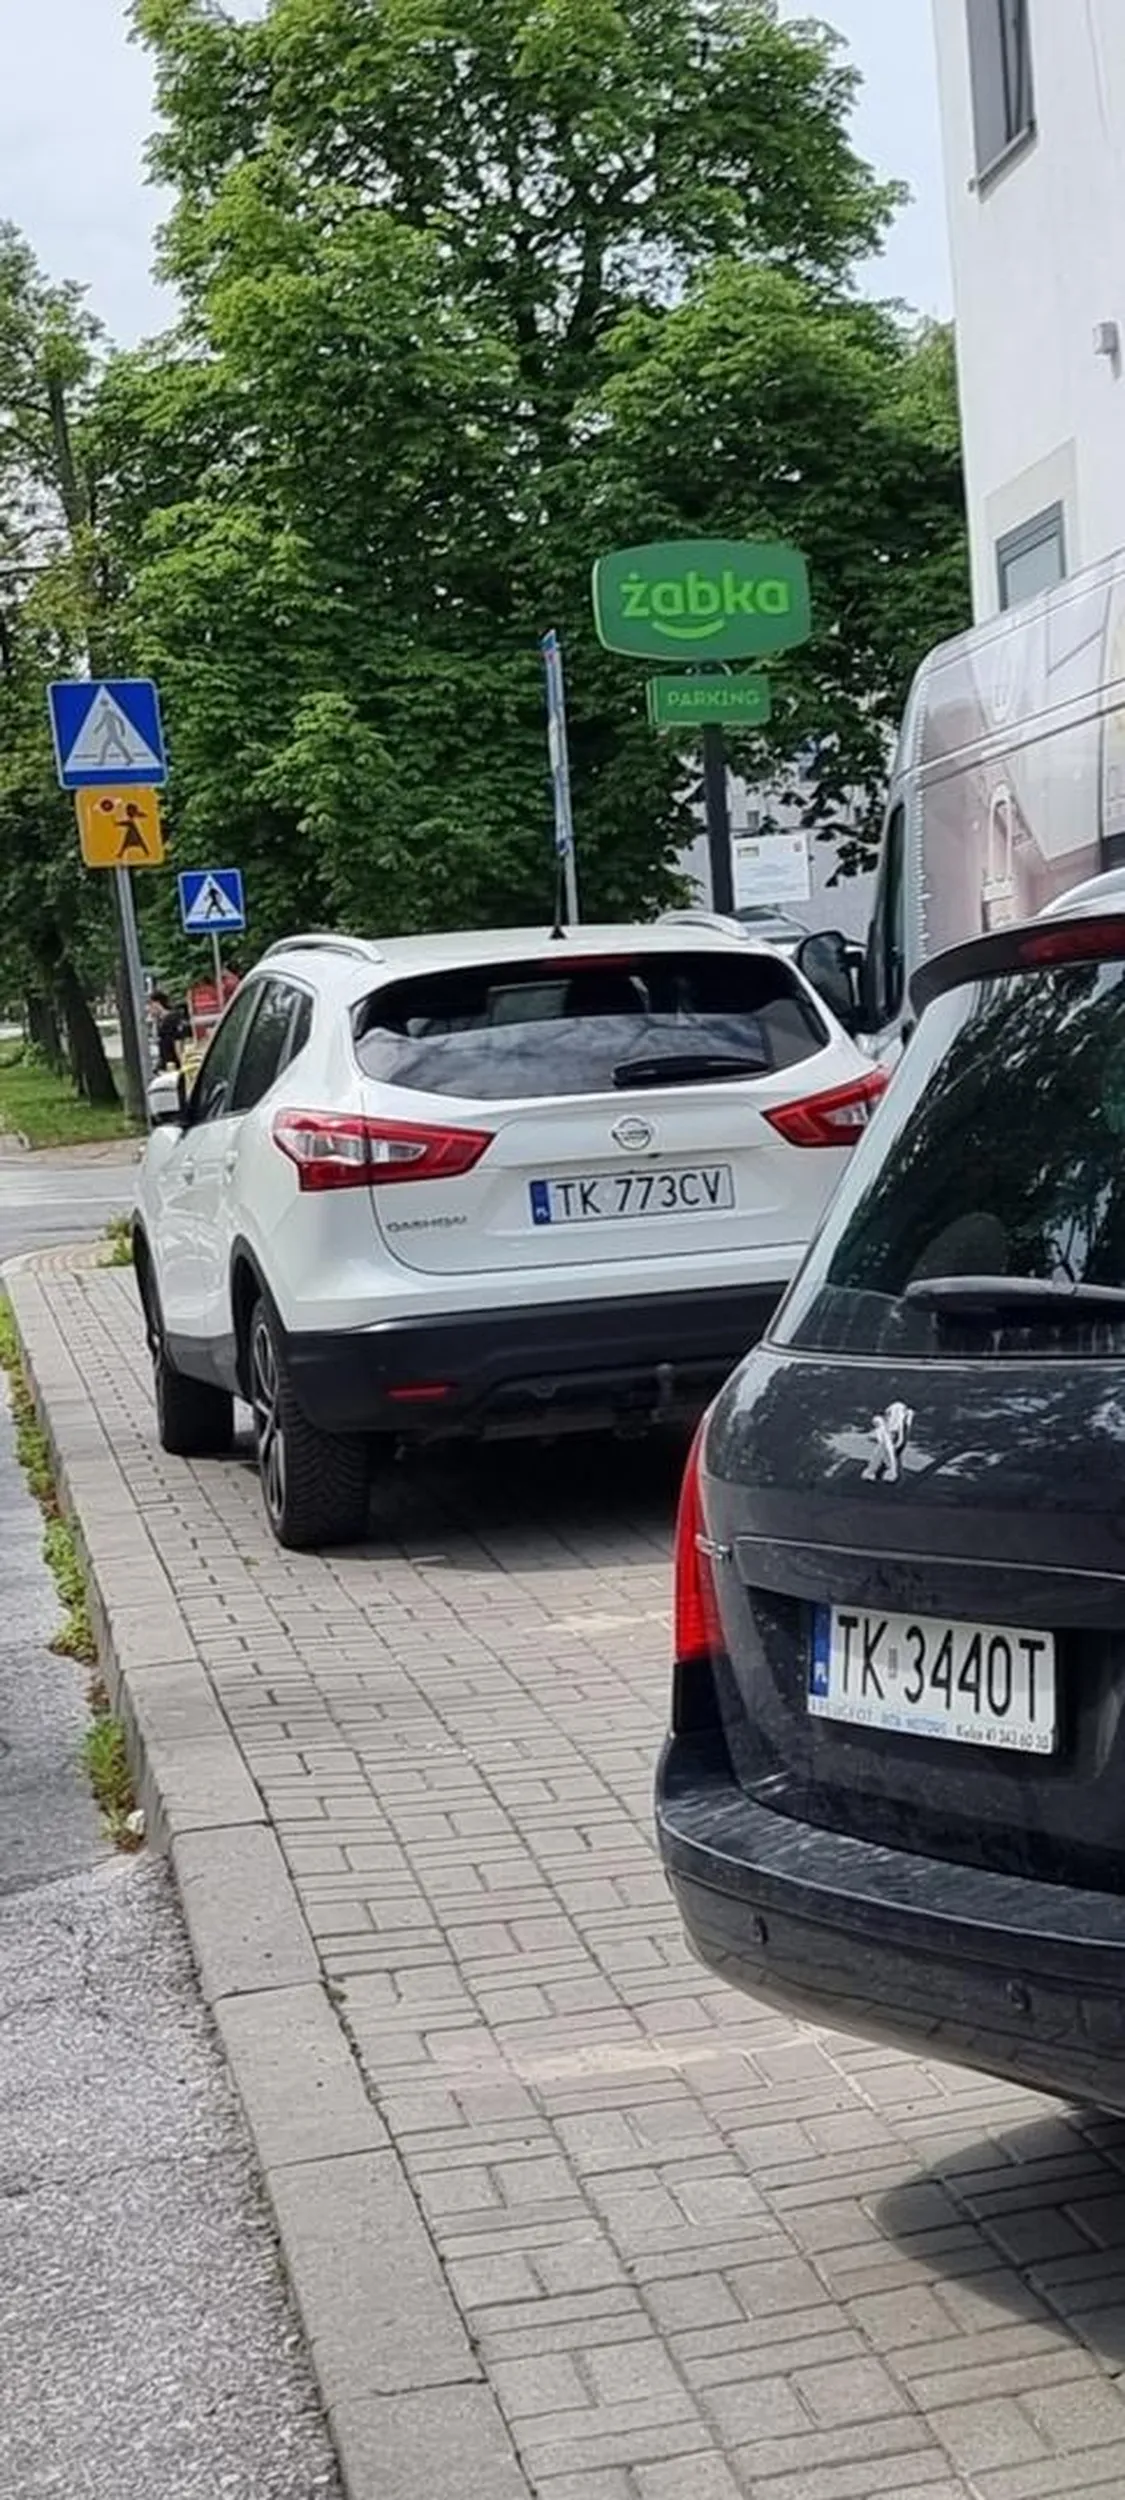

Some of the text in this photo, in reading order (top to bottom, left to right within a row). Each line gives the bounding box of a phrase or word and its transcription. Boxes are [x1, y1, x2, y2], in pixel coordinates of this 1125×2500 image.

[619, 571, 790, 617] żabka
[667, 690, 760, 707] PARKING
[555, 1171, 720, 1217] TK 773CV
[837, 1614, 1046, 1722] TK 3440T
